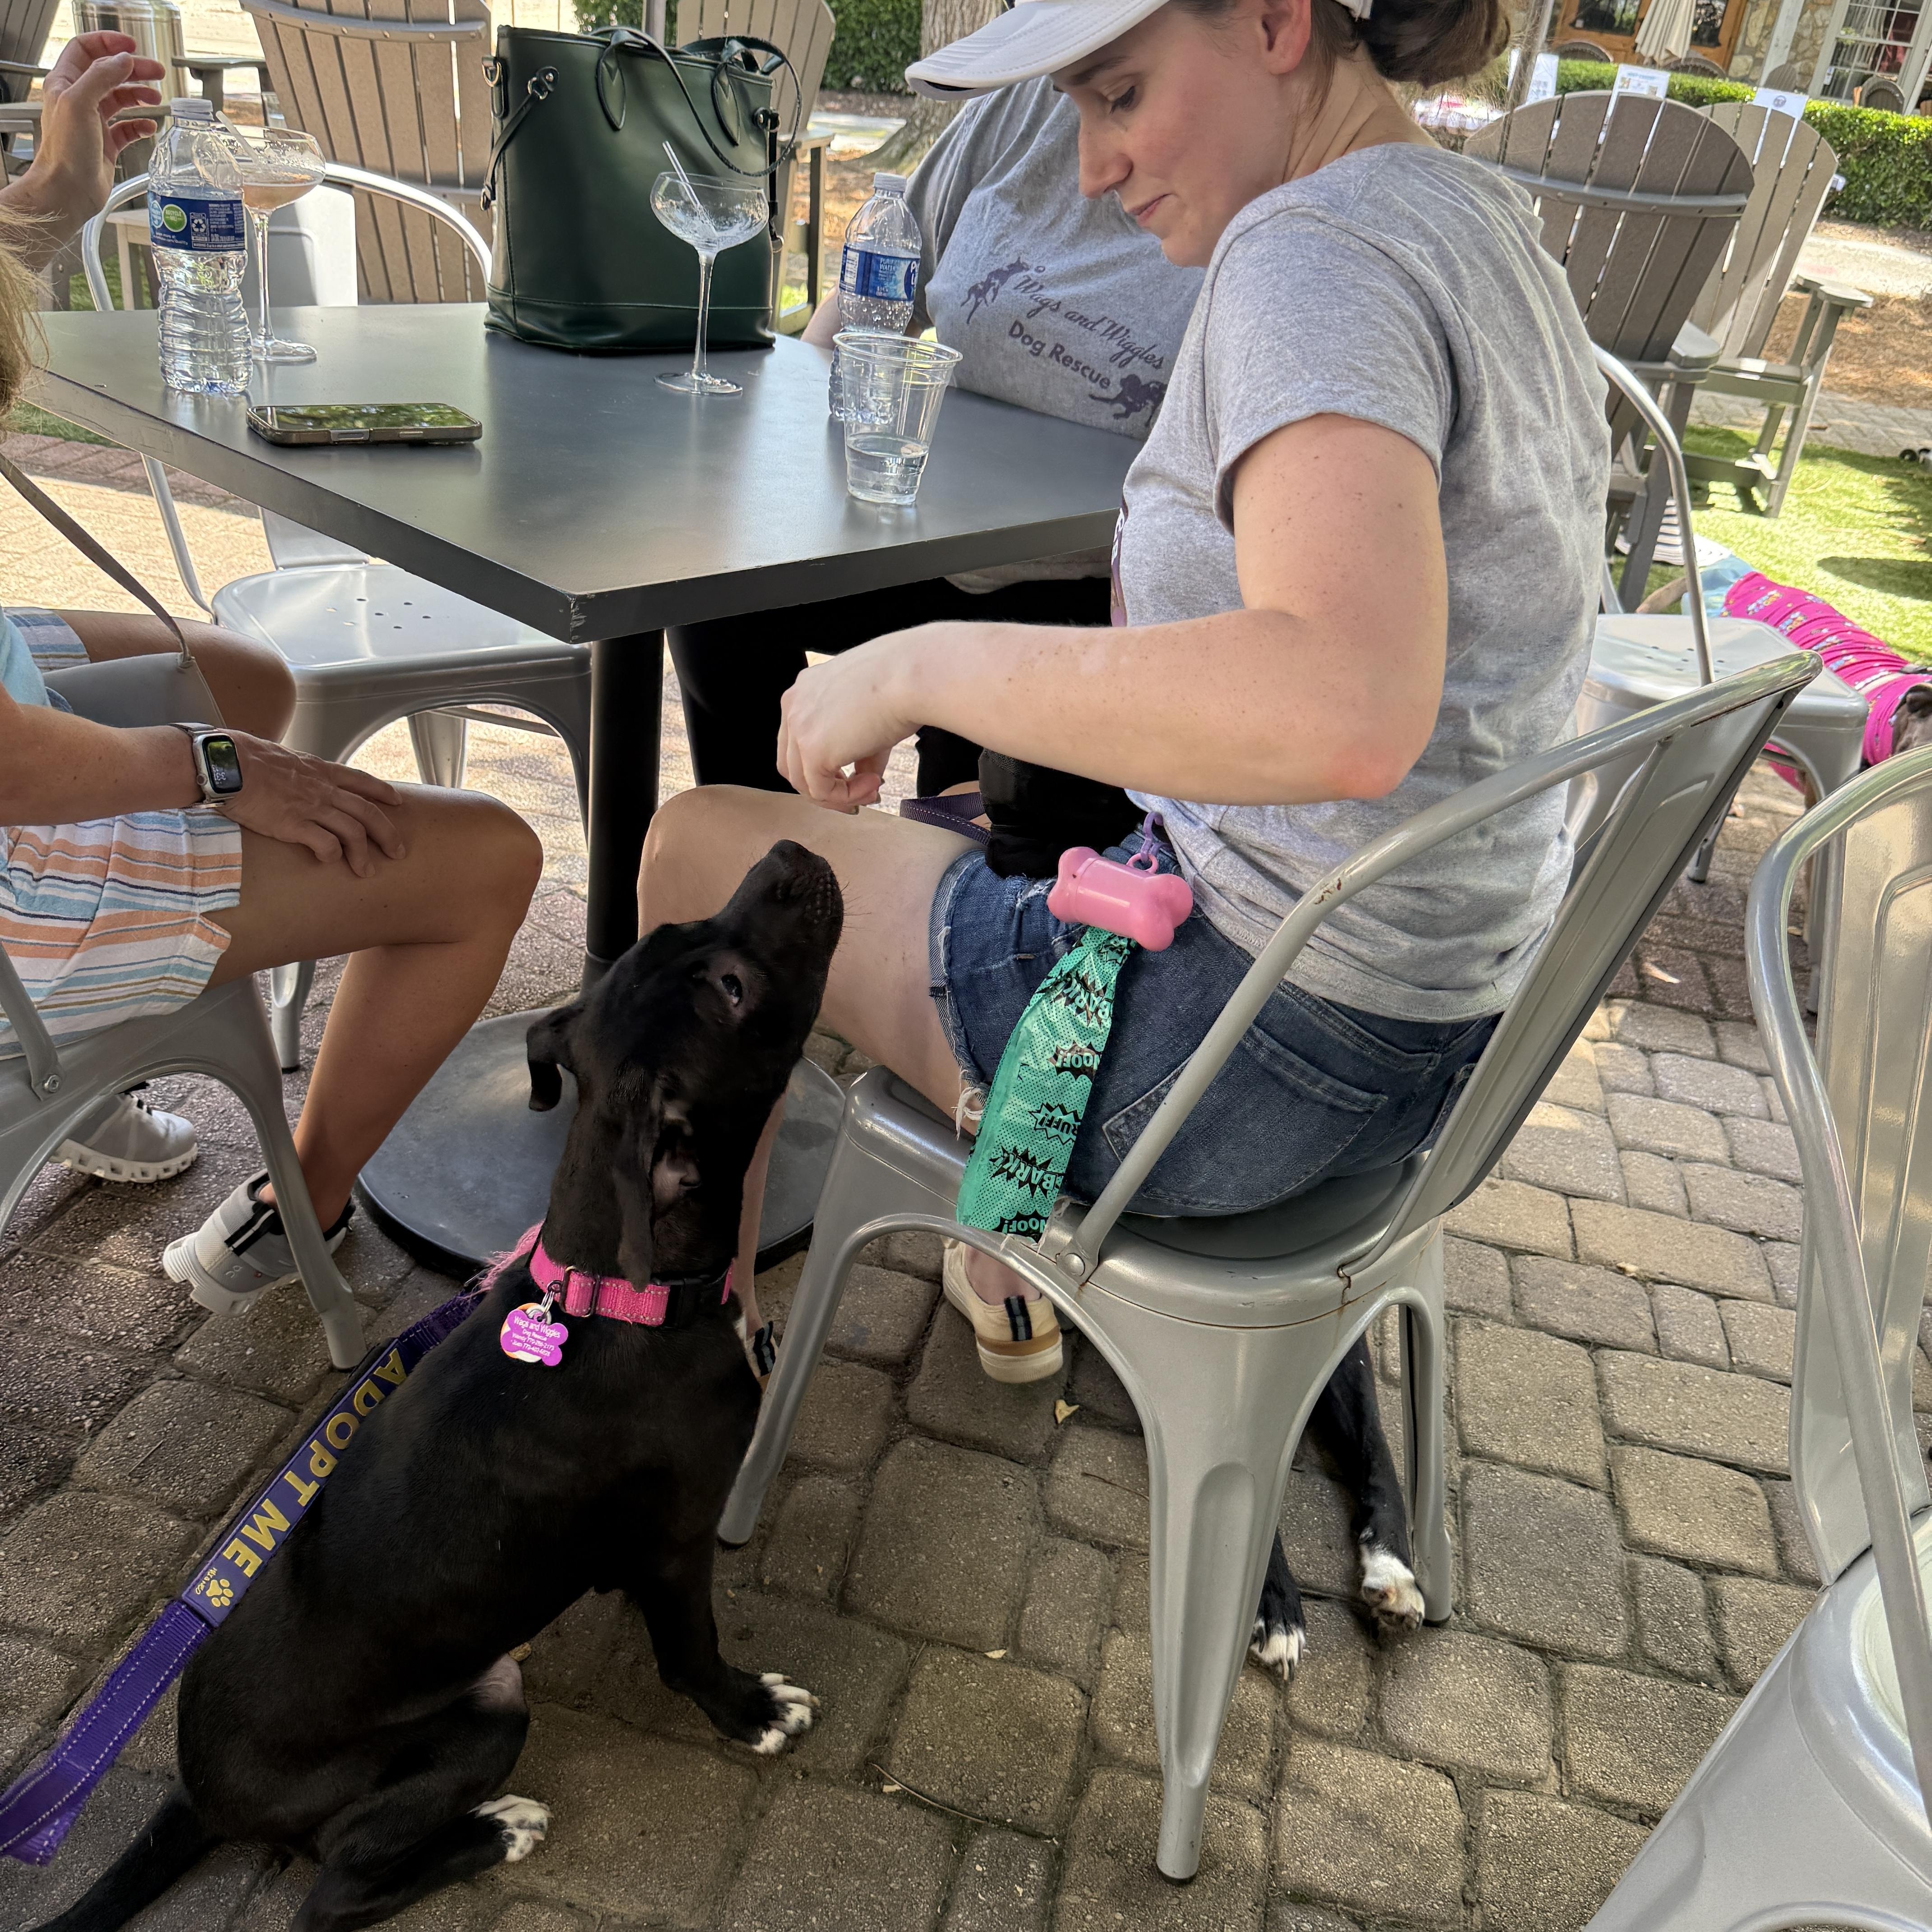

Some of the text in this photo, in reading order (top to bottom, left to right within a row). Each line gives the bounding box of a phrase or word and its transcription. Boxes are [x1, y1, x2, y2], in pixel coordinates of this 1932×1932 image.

[1008, 320, 1111, 390] Dog Rescue
[1014, 274, 1164, 370] Wags and Wiggles
[994, 1152, 1057, 1191] BARK!
[529, 1322, 541, 1331] and
[222, 1348, 406, 1578] ADOPT ME
